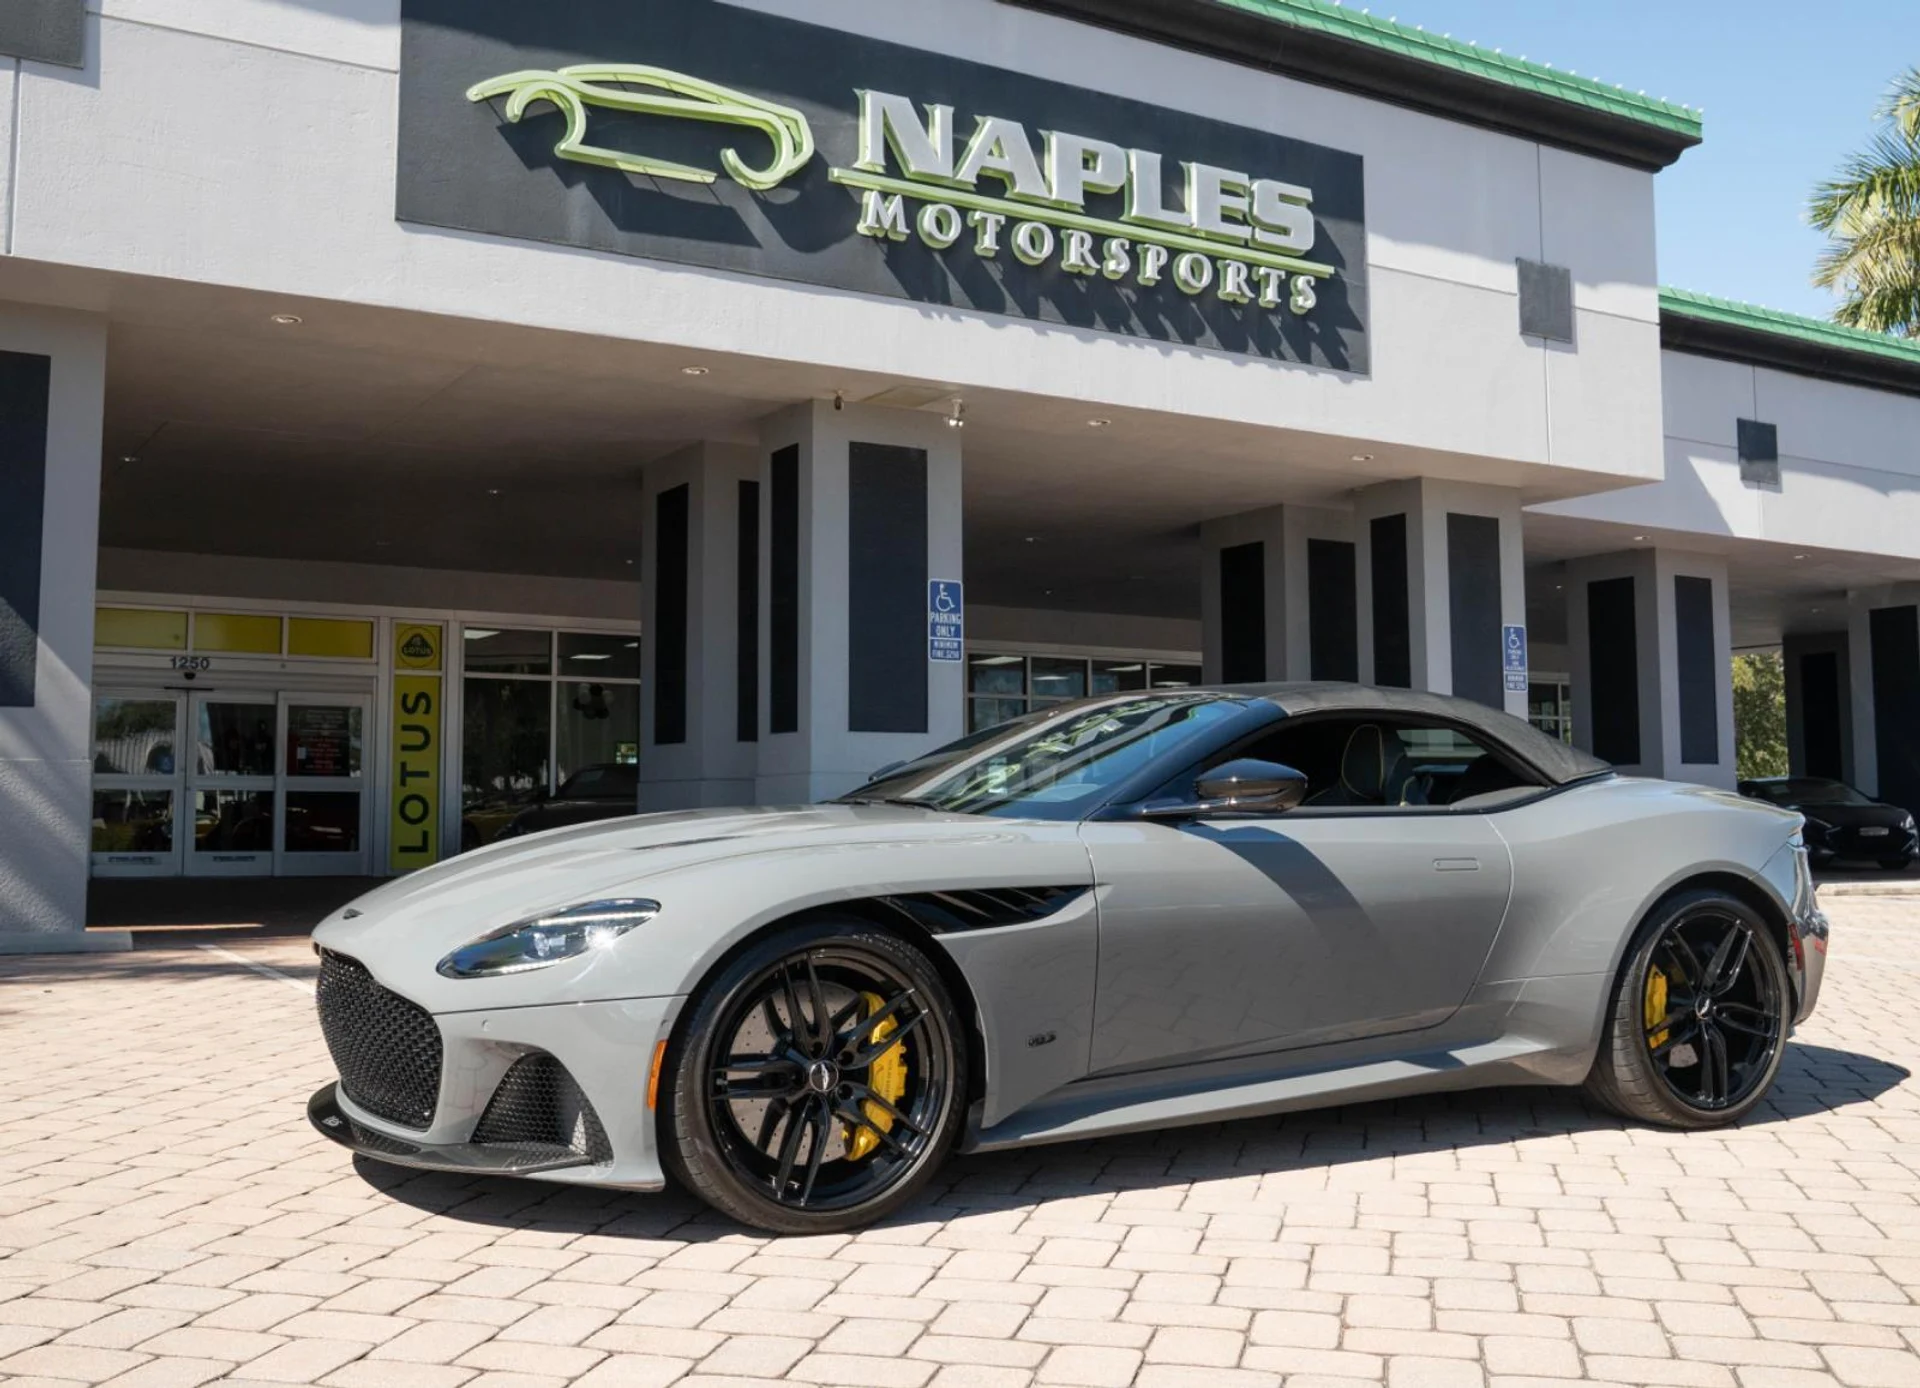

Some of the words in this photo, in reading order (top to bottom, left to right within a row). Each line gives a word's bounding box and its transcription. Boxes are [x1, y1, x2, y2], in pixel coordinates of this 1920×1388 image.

[854, 88, 1315, 256] NAPLES
[857, 190, 1317, 314] MOTORSPORTS
[931, 612, 961, 624] PARKING
[936, 625, 955, 637] ONLY
[403, 645, 433, 656] LOTUS
[170, 655, 210, 670] 1250
[398, 692, 432, 853] LOTUS
